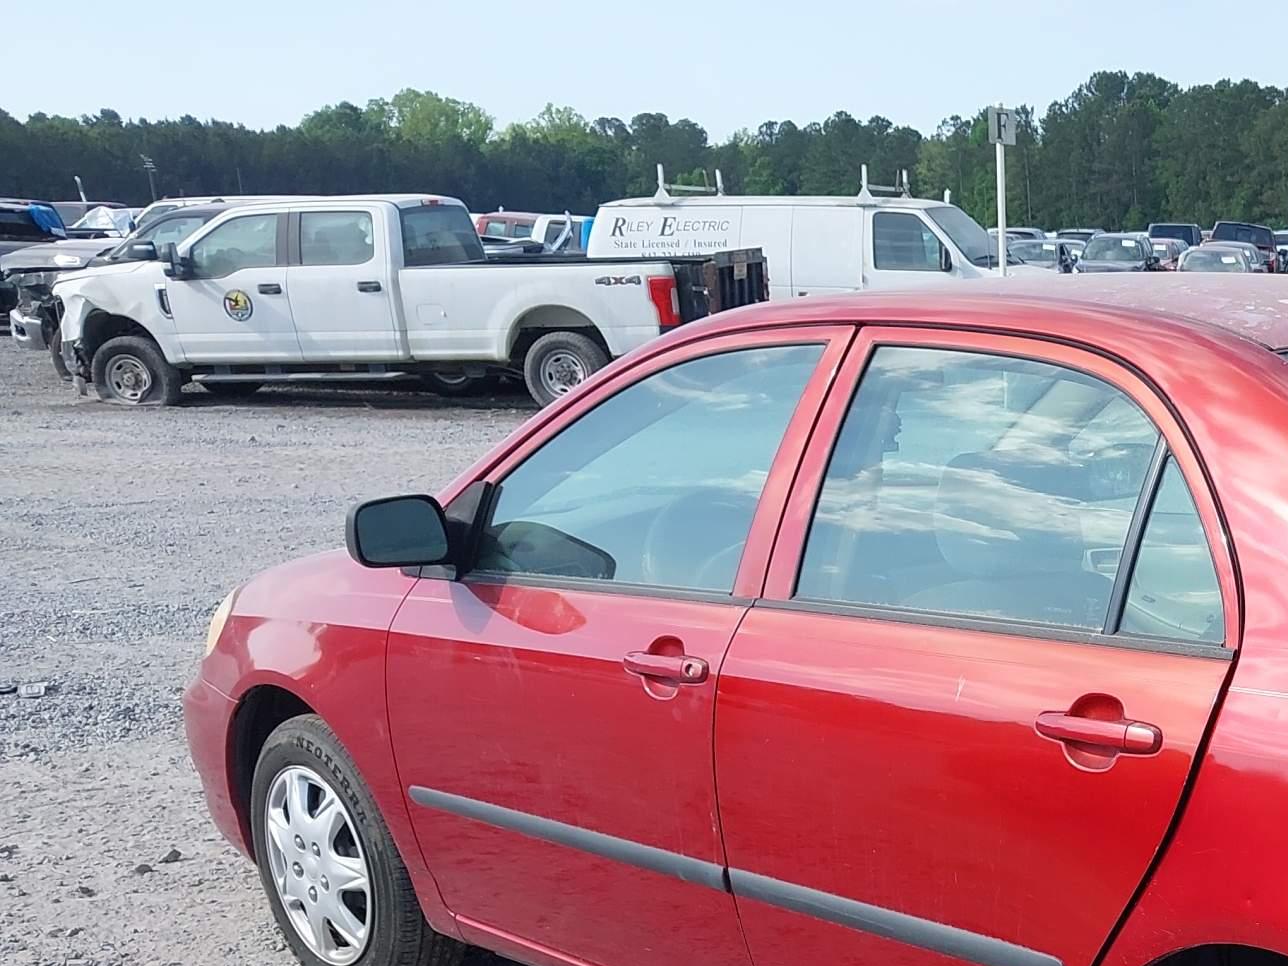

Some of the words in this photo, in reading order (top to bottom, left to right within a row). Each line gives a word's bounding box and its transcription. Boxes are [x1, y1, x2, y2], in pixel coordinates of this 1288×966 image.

[997, 112, 1009, 139] F
[610, 216, 653, 237] RILEY
[658, 216, 730, 237] ELECTRIC
[614, 240, 637, 248] State
[642, 239, 680, 248] Licensed
[693, 239, 728, 248] Insured
[295, 735, 368, 825] NEOTERRA
